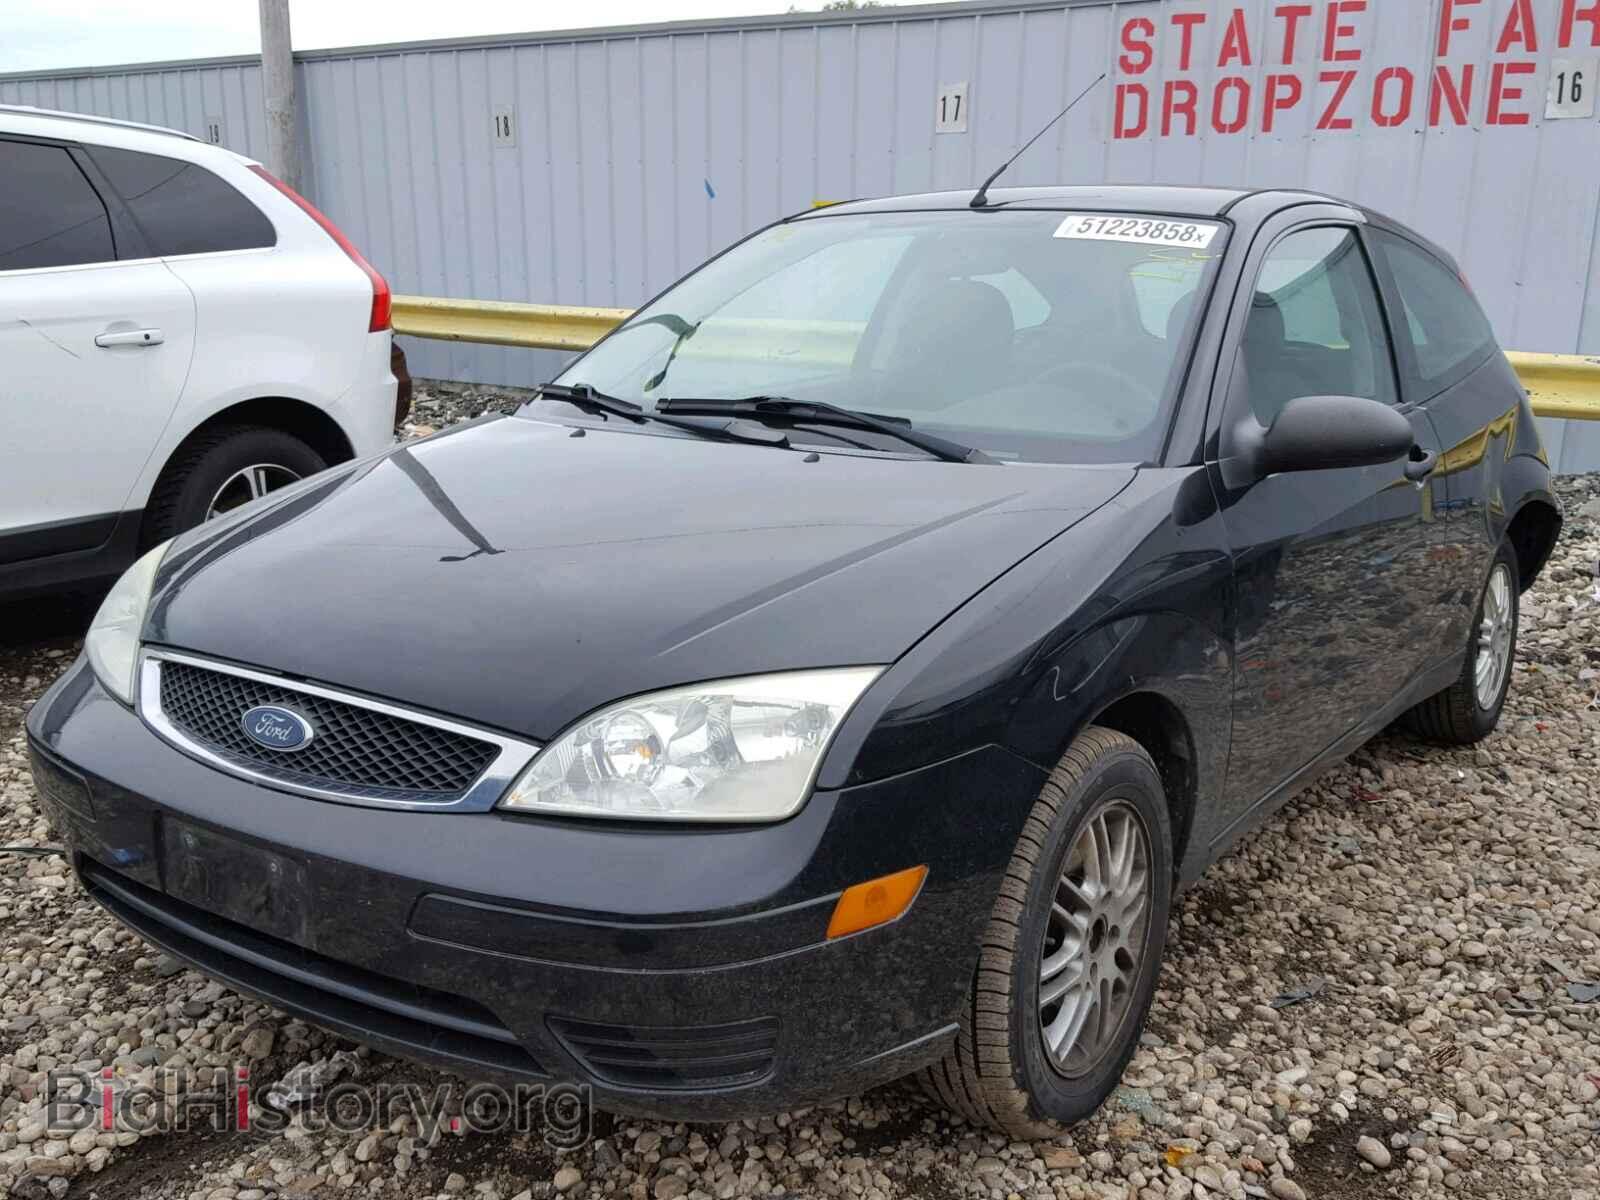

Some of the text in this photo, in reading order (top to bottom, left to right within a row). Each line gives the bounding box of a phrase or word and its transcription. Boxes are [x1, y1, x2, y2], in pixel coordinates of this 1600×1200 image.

[1119, 0, 1600, 75] STATE FAR
[1113, 62, 1537, 140] DROPZONE
[1556, 71, 1584, 105] 16
[941, 95, 961, 122] 17
[495, 115, 510, 137] 18
[255, 712, 294, 741] Ford
